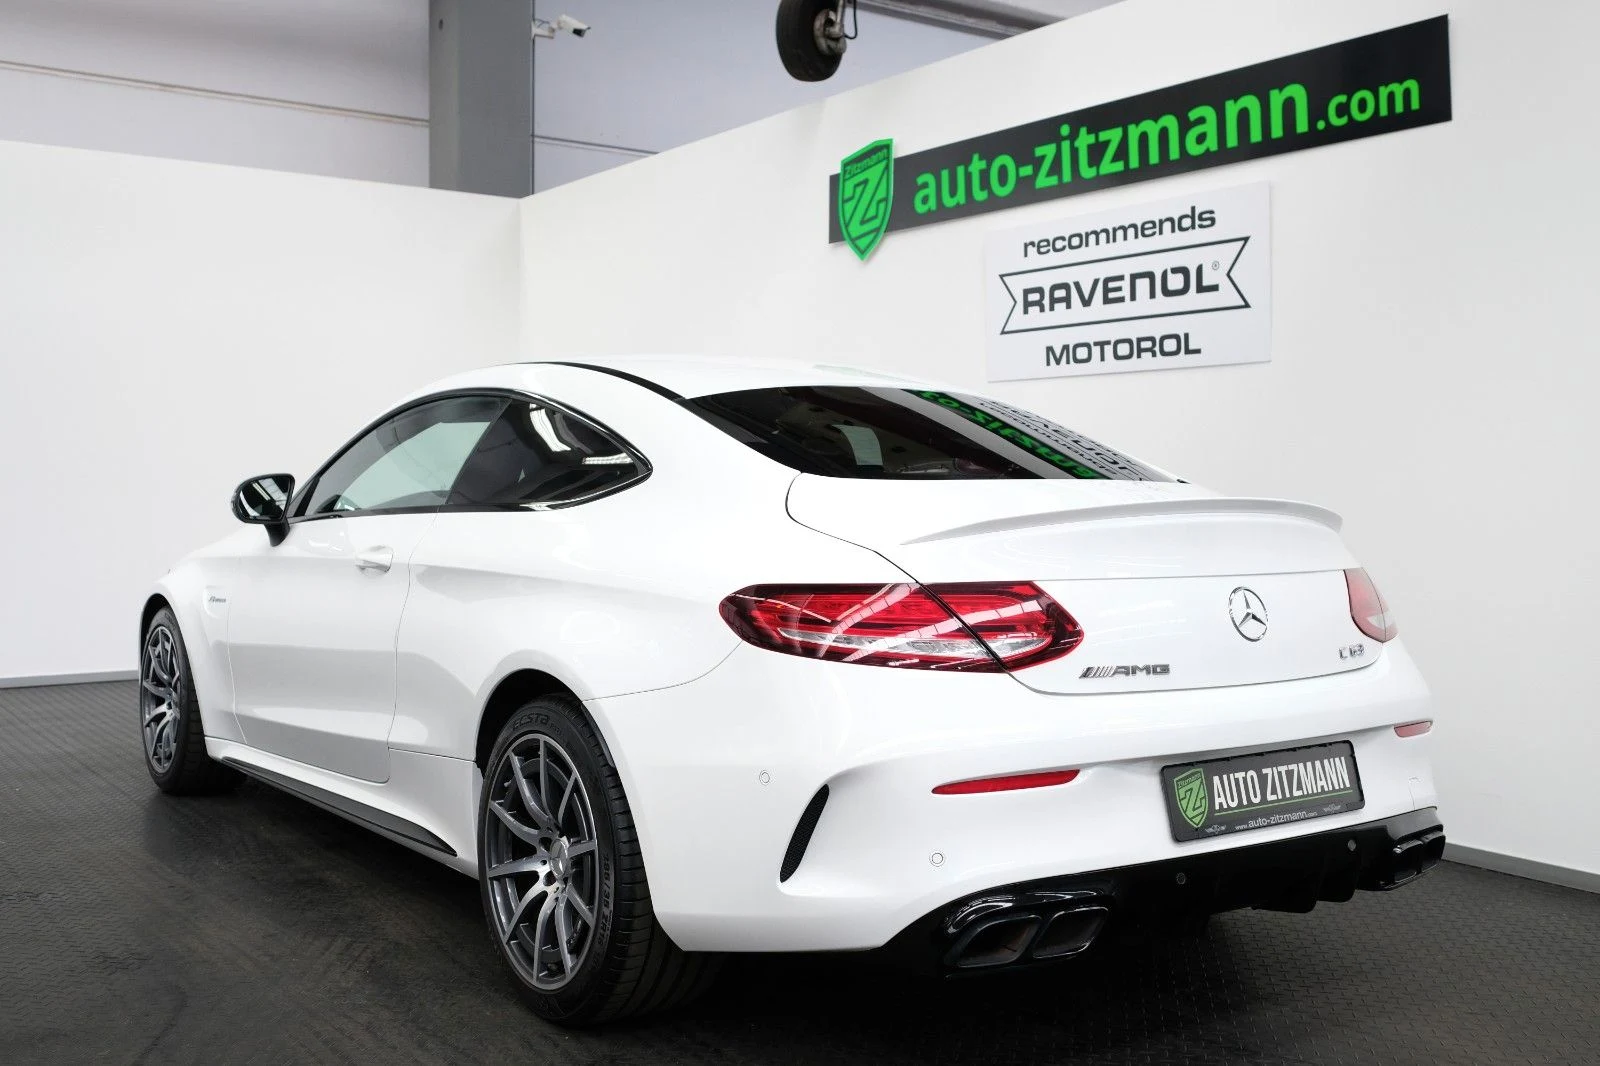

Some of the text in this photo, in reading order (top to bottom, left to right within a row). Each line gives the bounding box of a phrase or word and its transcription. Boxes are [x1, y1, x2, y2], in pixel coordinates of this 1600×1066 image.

[844, 148, 888, 178] Zitzmann
[913, 79, 1421, 214] auto-zitzmann.com
[1023, 206, 1216, 258] recommends
[1045, 331, 1202, 367] MOTOROL
[1213, 756, 1351, 811] AUTO ZITZMANN
